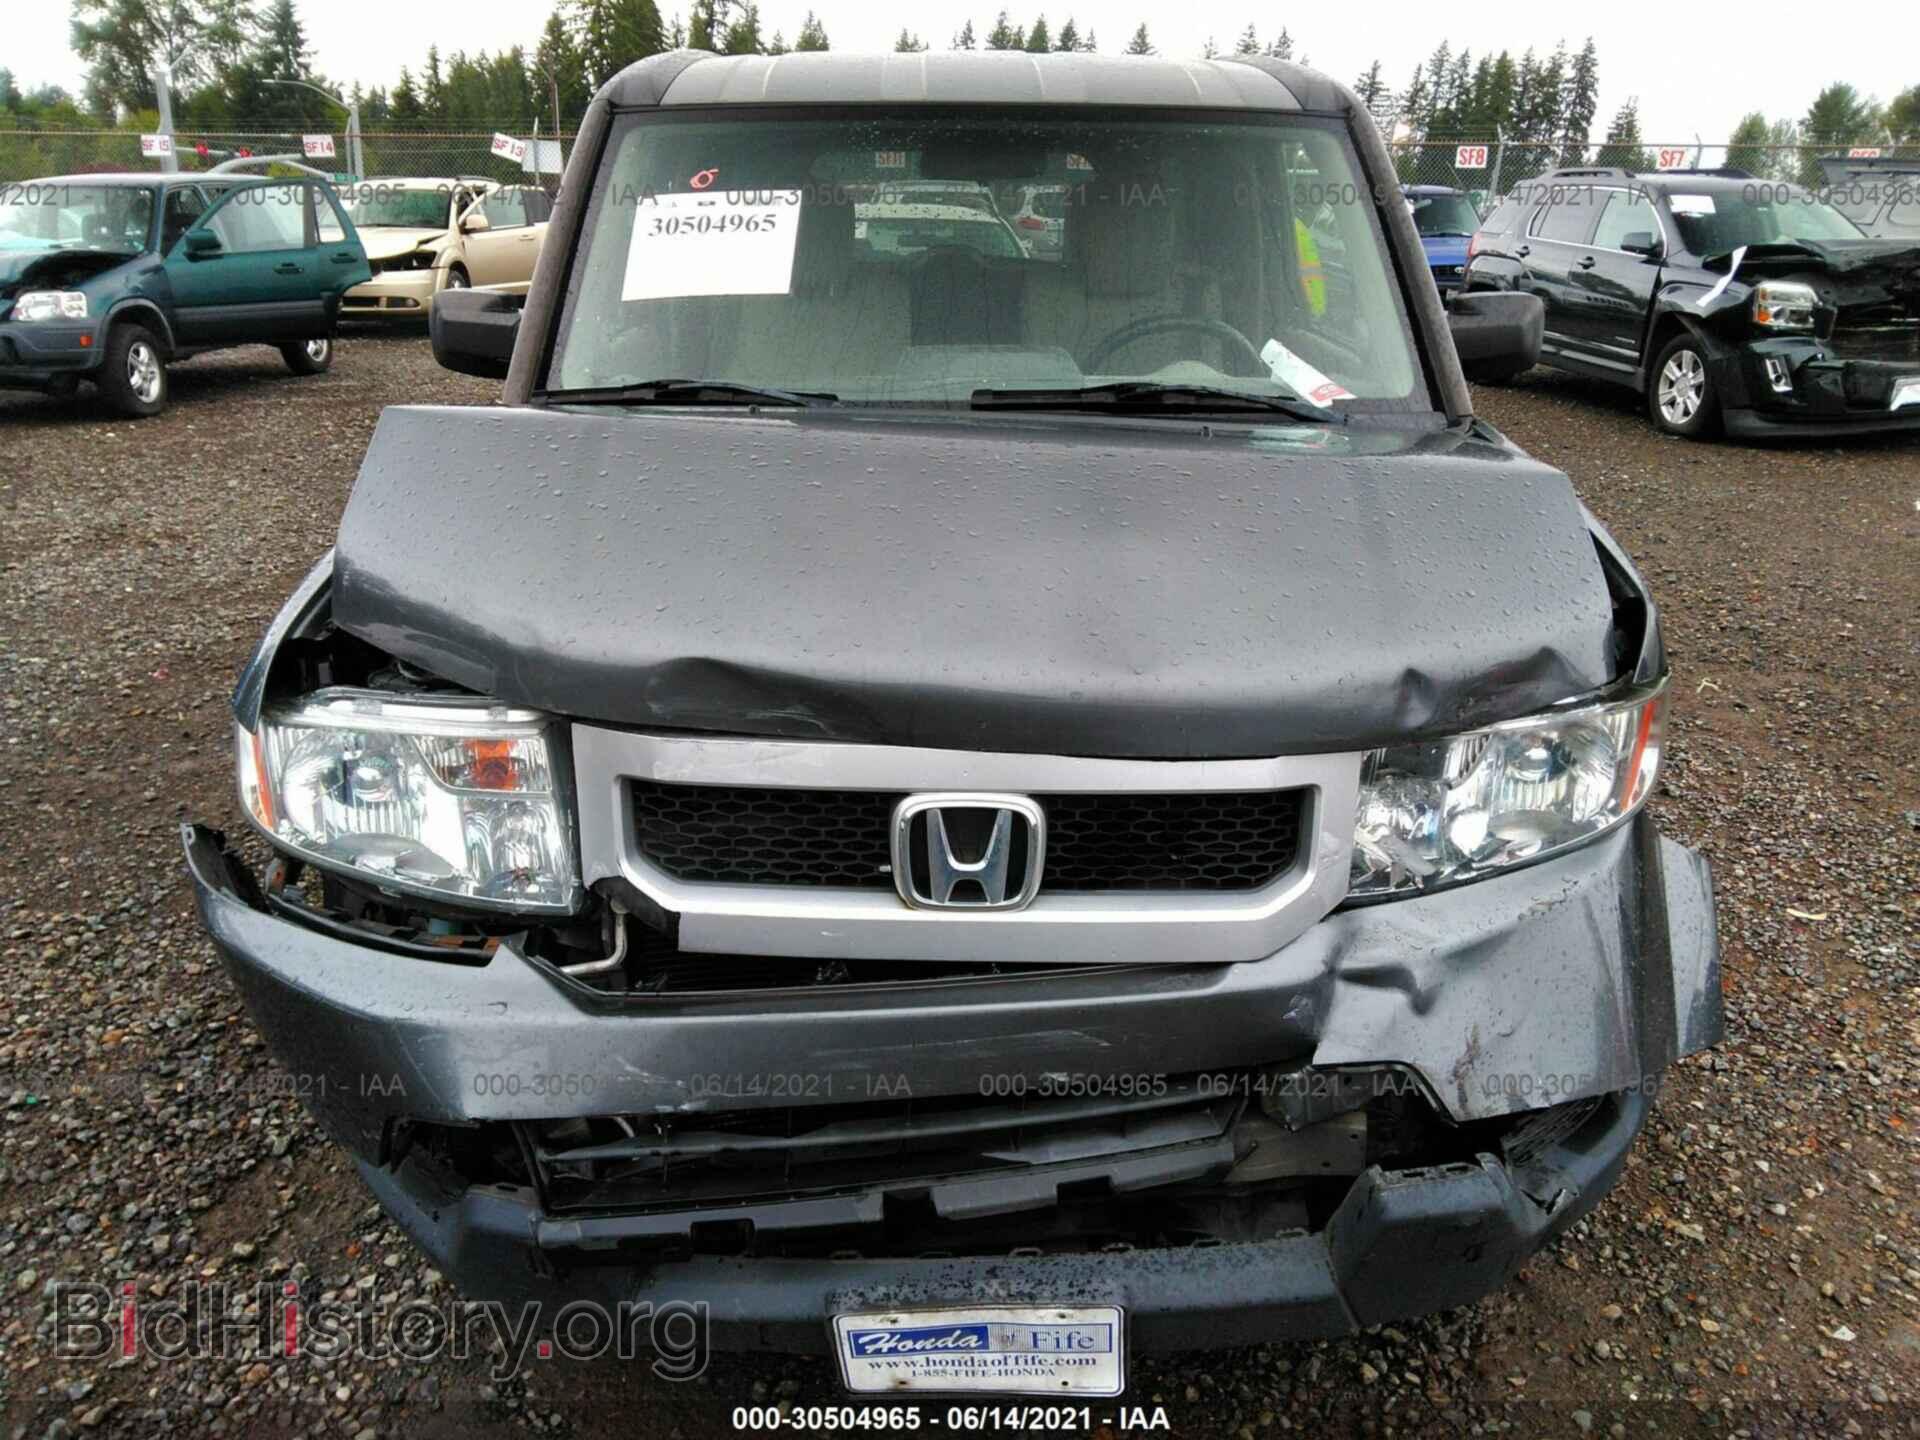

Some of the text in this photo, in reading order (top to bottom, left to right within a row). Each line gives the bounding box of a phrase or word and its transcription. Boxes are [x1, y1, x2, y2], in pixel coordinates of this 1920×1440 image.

[1458, 148, 1485, 166] SF8
[1659, 150, 1686, 168] SF7
[647, 213, 776, 238] 30504965
[858, 1329, 983, 1354] Honda
[1031, 1331, 1096, 1350] Fife
[867, 1354, 1097, 1370] www.hondaoffife.com
